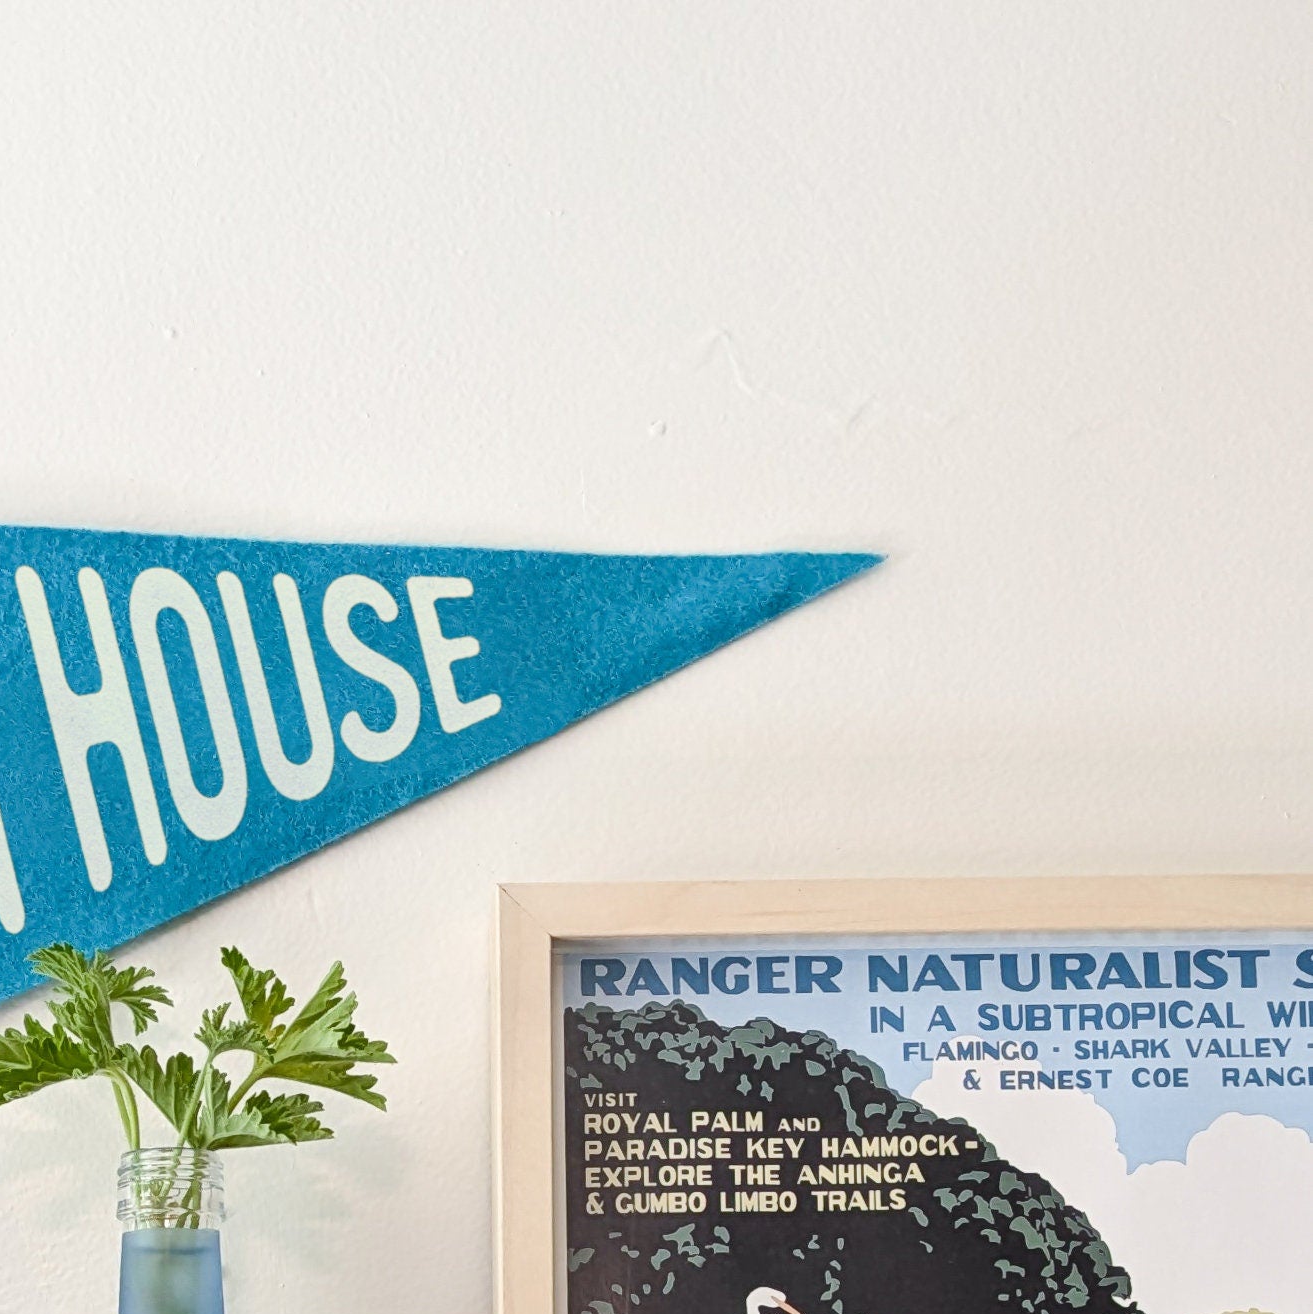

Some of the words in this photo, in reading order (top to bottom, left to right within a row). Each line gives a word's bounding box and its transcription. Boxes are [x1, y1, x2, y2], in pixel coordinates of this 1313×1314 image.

[16, 565, 503, 892] HOUSE
[580, 955, 843, 995] RANGER
[868, 949, 1270, 992] NATURALIST
[871, 1006, 904, 1033] IN
[928, 1006, 956, 1031] A
[978, 1001, 1244, 1031] SUBTROPICAL
[1267, 1001, 1313, 1027] WI
[904, 1041, 1038, 1061] FLAMINGO
[1075, 1039, 1170, 1059] SHARK
[1186, 1038, 1291, 1057] VALLEY
[963, 1069, 981, 1090] &
[1001, 1070, 1112, 1089] ERNEST
[1132, 1068, 1188, 1087] COE
[1222, 1067, 1313, 1087] RANG
[585, 1093, 637, 1107] VISIT
[585, 1113, 677, 1134] ROYAL
[692, 1111, 763, 1132] PALM
[778, 1118, 820, 1131] AND
[585, 1138, 731, 1161] PARADISE
[747, 1138, 804, 1158] KEY
[586, 1165, 712, 1187] EXPLORE
[729, 1165, 780, 1185] THE
[797, 1163, 925, 1184] ANHINGA
[586, 1192, 604, 1214] &
[616, 1192, 706, 1213] GUMBO
[721, 1191, 797, 1212] LIMBO
[811, 1189, 906, 1211] TRAILS
